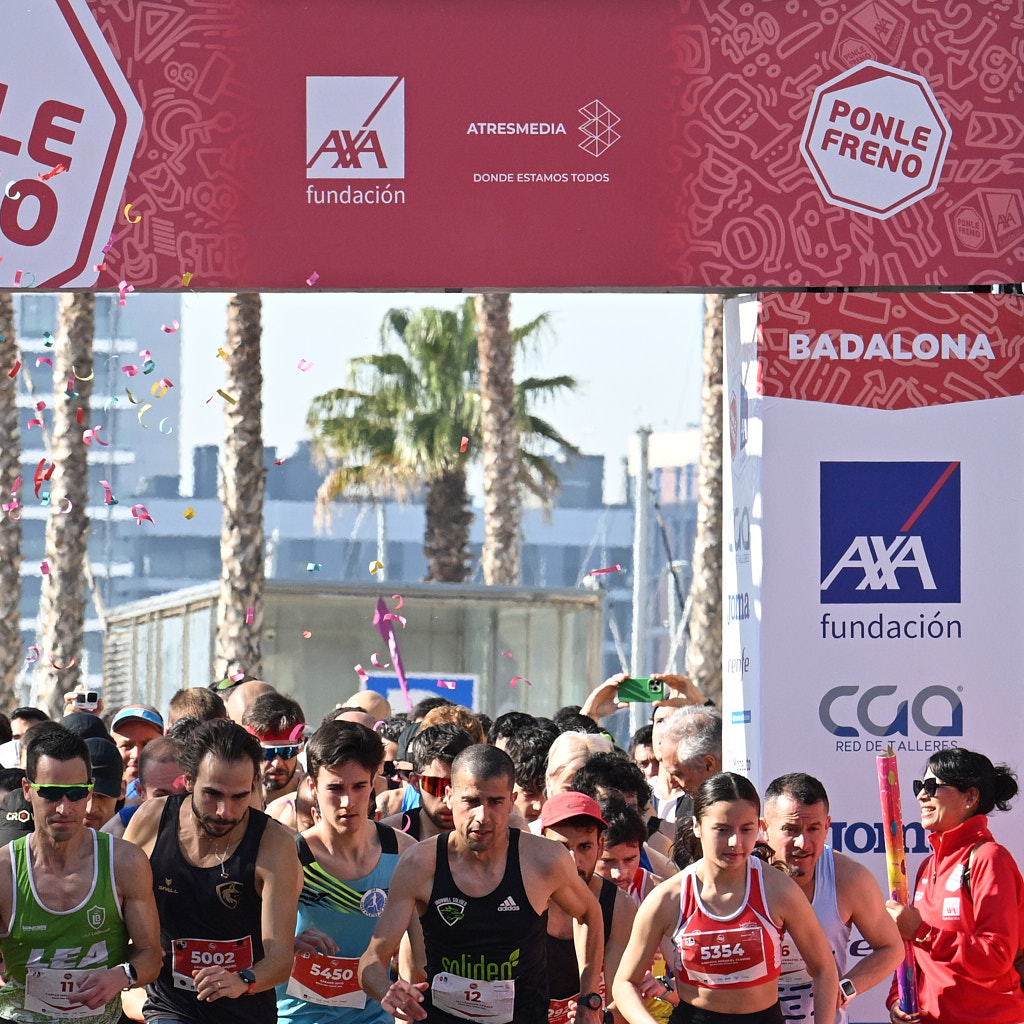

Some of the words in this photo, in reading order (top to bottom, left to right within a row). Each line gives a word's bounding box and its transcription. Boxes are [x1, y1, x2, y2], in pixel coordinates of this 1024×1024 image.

[467, 122, 566, 135] ATRESMEDIA
[828, 99, 932, 152] PONLE
[306, 129, 389, 169] AXA
[820, 128, 923, 179] FRENO
[473, 173, 516, 182] DONDE
[517, 173, 569, 182] ESTAMOS
[571, 173, 610, 182] TODOS
[306, 184, 406, 205] fundación
[788, 334, 996, 360] BADALONA
[820, 535, 938, 590] AXA
[820, 611, 962, 639] fundación
[836, 740, 862, 752] RED
[865, 740, 882, 752] DE
[25, 940, 109, 969] LEA
[190, 951, 236, 965] 5002
[700, 943, 745, 960] 5354
[310, 963, 354, 981] 5450
[60, 981, 74, 993] 11
[464, 990, 482, 1002] 12
